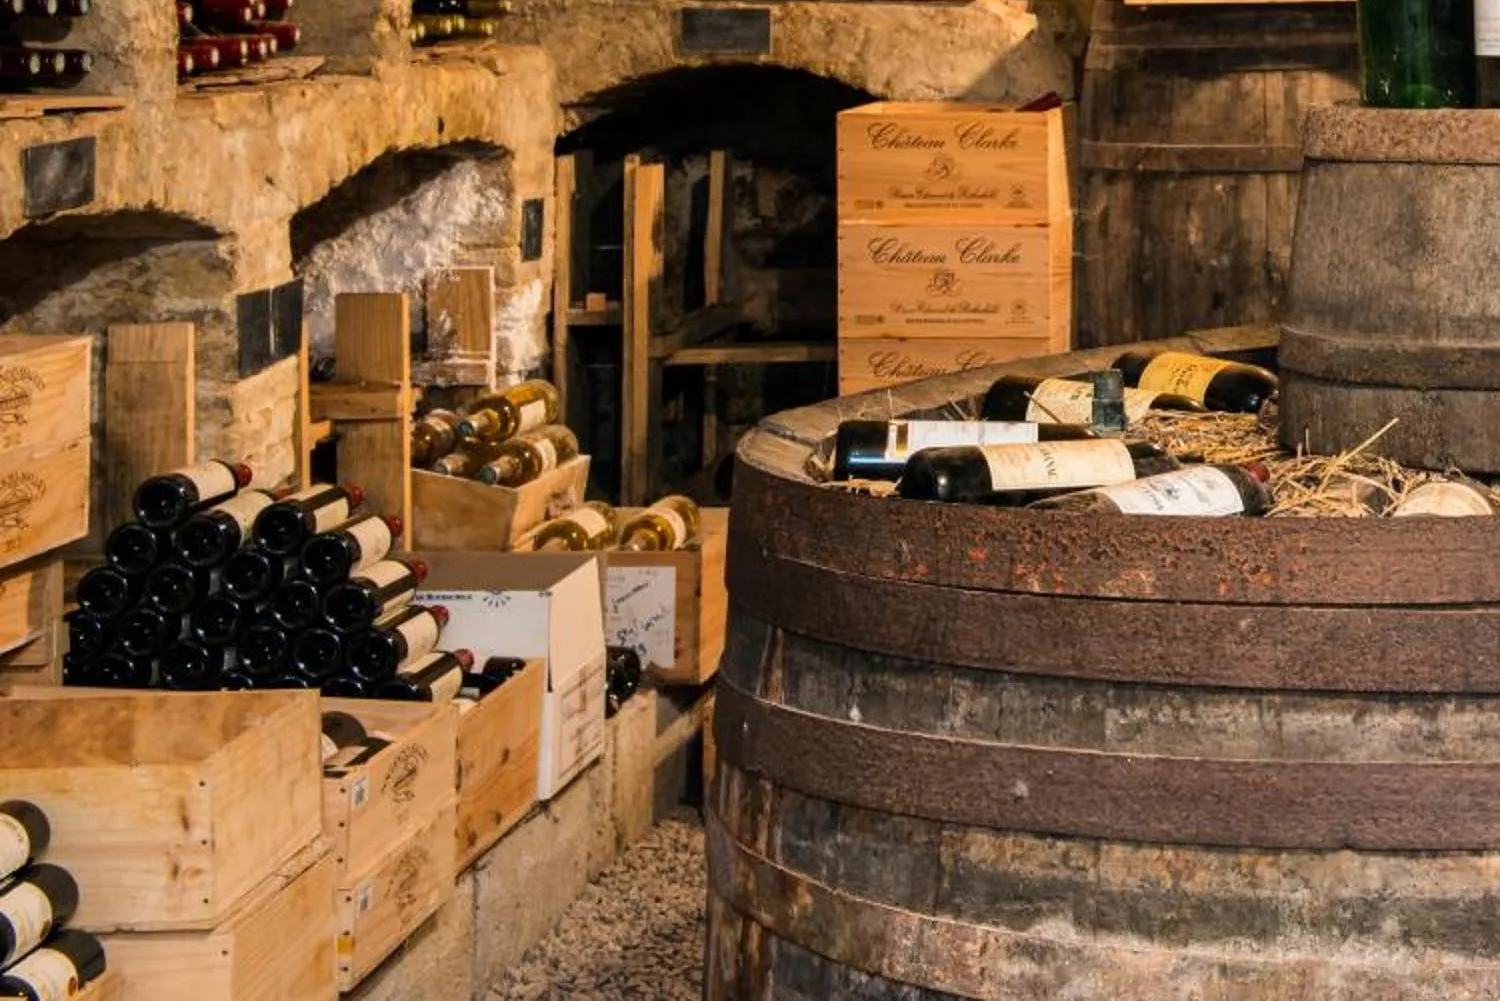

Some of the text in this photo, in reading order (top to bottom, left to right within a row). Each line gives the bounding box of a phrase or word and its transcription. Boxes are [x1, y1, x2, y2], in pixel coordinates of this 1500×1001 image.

[867, 121, 1021, 149] Château Clarke
[867, 237, 1021, 264] Château Clarke
